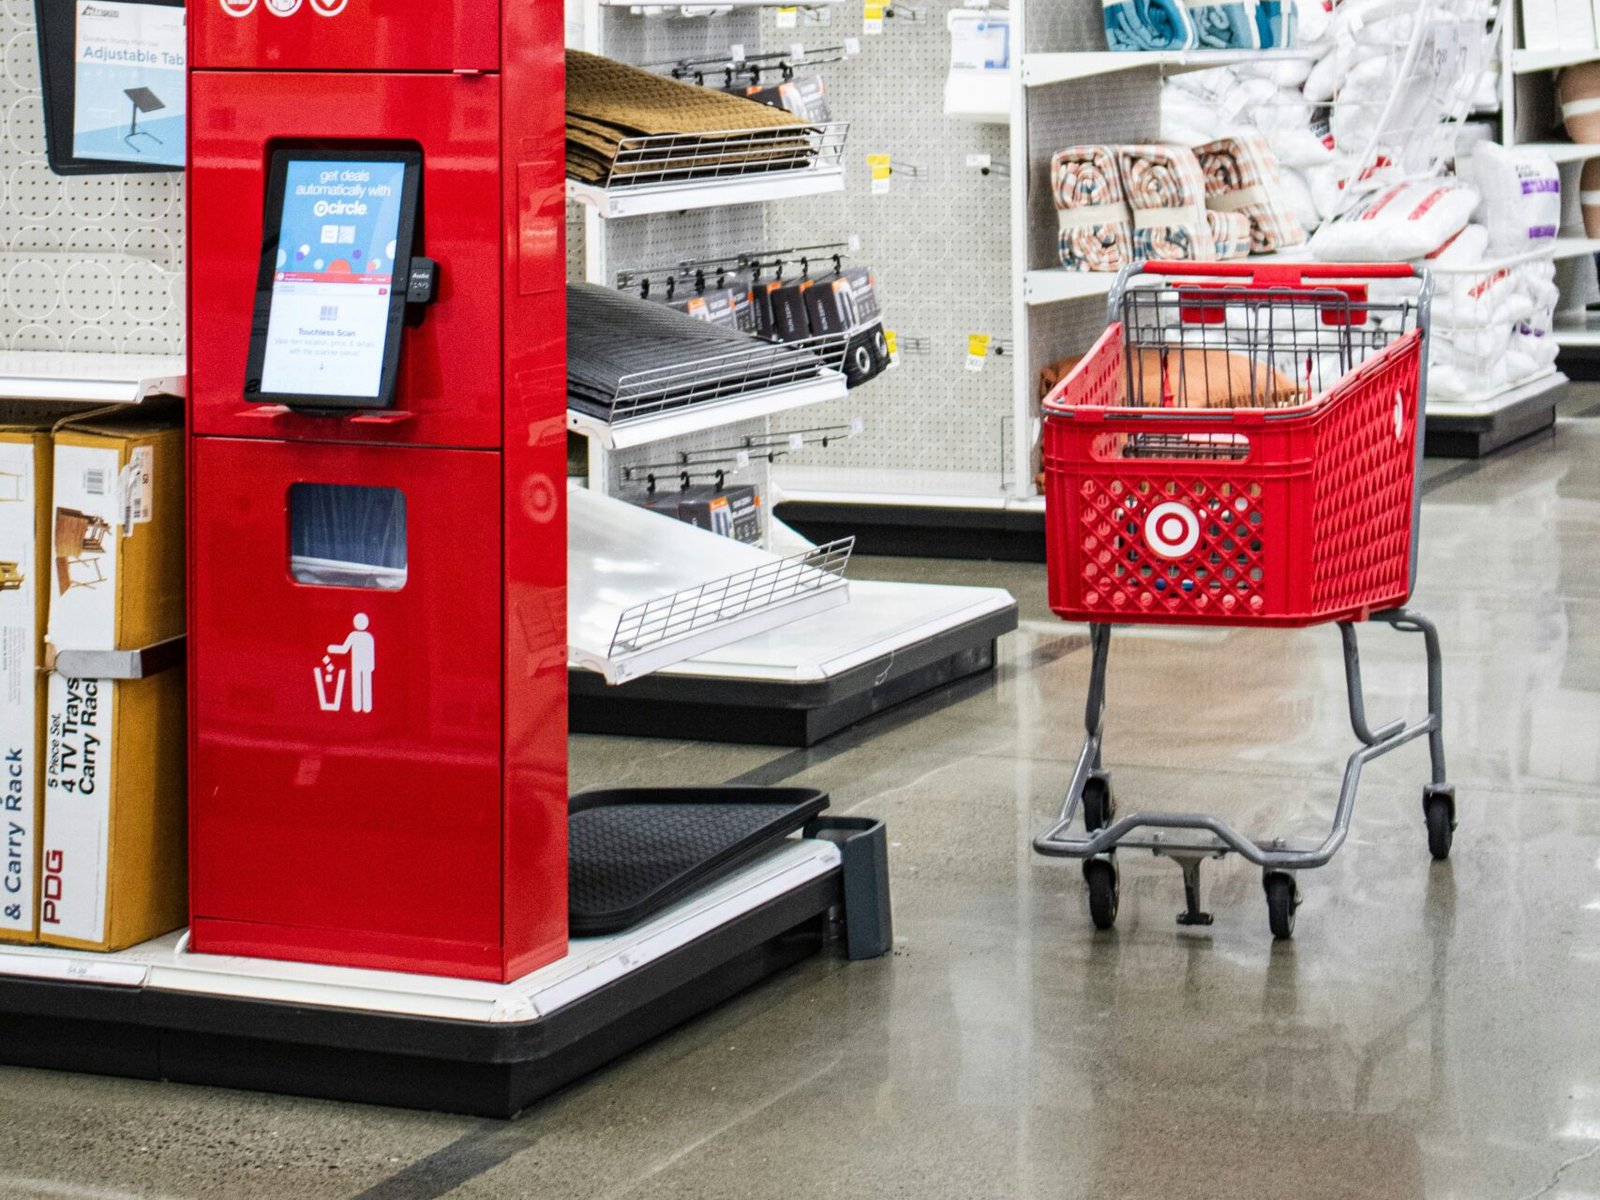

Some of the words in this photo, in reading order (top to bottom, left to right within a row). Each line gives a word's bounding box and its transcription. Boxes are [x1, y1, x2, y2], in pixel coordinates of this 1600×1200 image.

[83, 45, 158, 64] Adjustable
[320, 169, 339, 184] get
[340, 169, 370, 182] deals
[295, 183, 367, 199] automatically
[367, 183, 392, 197] with
[328, 200, 368, 215] circle
[62, 677, 84, 737] Trays
[48, 738, 61, 777] Piece
[60, 744, 78, 774] TV
[78, 732, 101, 795] Carry
[4, 747, 23, 812] Rack
[47, 777, 58, 789] 5
[61, 778, 76, 793] 4
[4, 822, 25, 893] Carry
[42, 848, 64, 925] PDG
[4, 903, 22, 921] &
